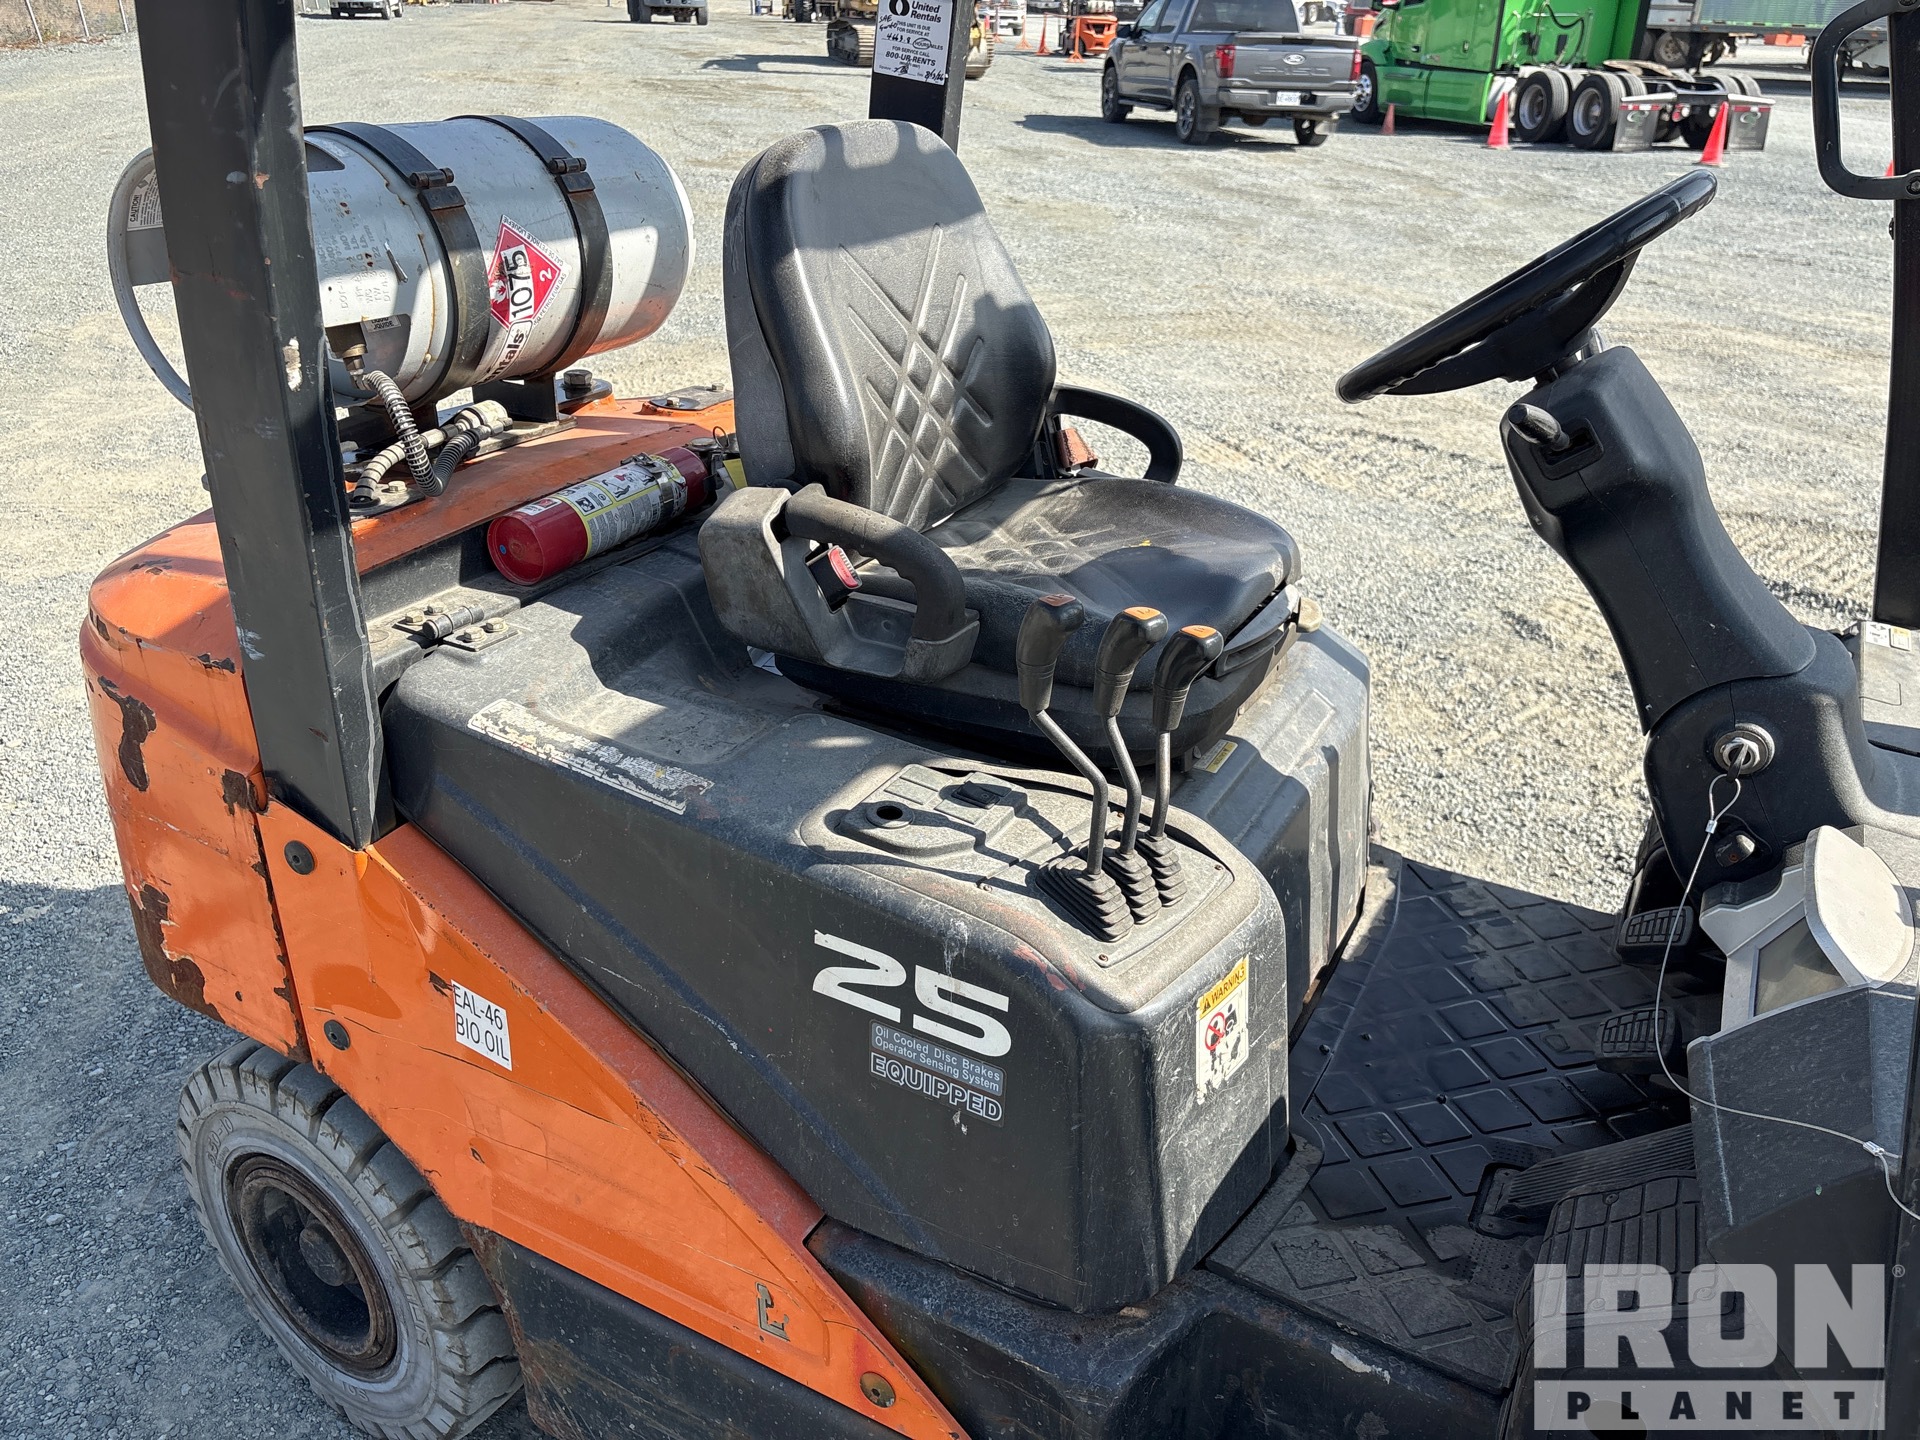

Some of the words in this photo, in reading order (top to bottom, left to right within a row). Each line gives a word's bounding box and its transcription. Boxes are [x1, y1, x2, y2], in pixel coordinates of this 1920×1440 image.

[910, 10, 942, 23] Rentals
[911, 1, 941, 13] United
[902, 47, 918, 55] SERVICE
[906, 28, 923, 36] SERVICE
[885, 50, 936, 66] 800-UR-RENTS
[506, 249, 534, 319] 1075
[538, 284, 561, 318] PETROLEUM
[556, 272, 567, 286] GAS
[539, 267, 553, 283] 2
[453, 983, 503, 1031] EAL-46
[812, 929, 1012, 1057] 25
[456, 1012, 480, 1044] BIO
[485, 1030, 509, 1062] OIL
[875, 1025, 889, 1039] Oil
[893, 1032, 929, 1055] Cooled
[934, 1044, 957, 1065] Disc
[962, 1058, 1000, 1081] Brakes
[870, 1051, 1003, 1122] EQUIPPED
[875, 1037, 917, 1060] Operator
[919, 1050, 960, 1078] Sensing
[962, 1069, 1000, 1092] System
